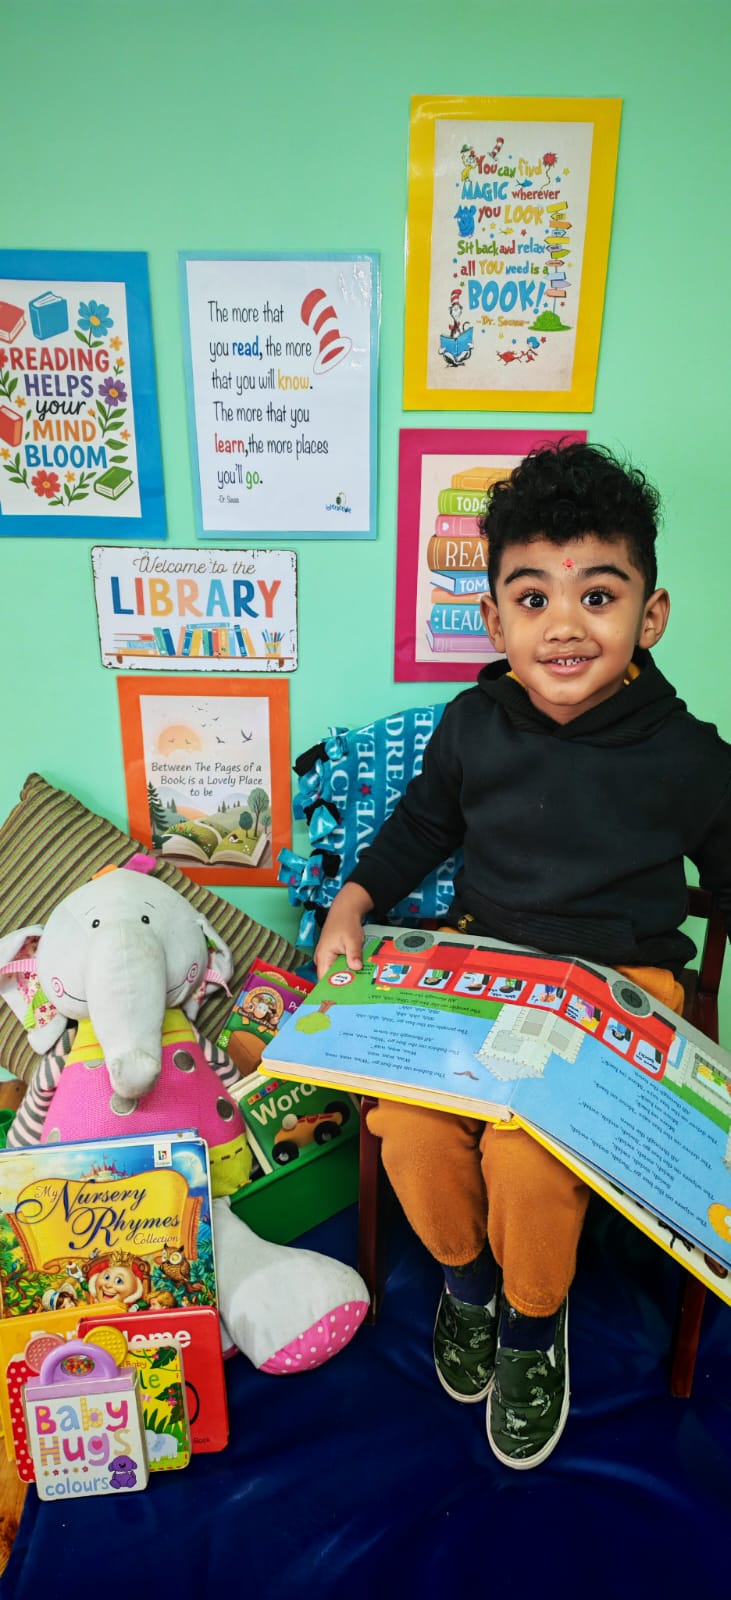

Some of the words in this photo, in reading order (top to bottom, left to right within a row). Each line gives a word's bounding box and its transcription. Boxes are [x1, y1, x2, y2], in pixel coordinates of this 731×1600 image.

[476, 155, 498, 175] You
[497, 166, 516, 178] can
[518, 157, 543, 177] find
[461, 181, 509, 202] MAGIC
[511, 188, 560, 200] wherever
[478, 206, 501, 223] you
[504, 204, 544, 225] LOOK
[457, 240, 474, 255] Sit
[475, 239, 499, 256] back
[499, 239, 516, 255] and
[517, 236, 545, 254] relax
[460, 260, 476, 276] all
[479, 259, 505, 275] YOU
[505, 260, 529, 275] need
[530, 262, 539, 275] is
[542, 266, 549, 275] a
[467, 280, 546, 314] BOOK!
[208, 301, 228, 322] The
[232, 304, 259, 323] more
[263, 301, 284, 323] that
[209, 341, 229, 362] you
[232, 335, 263, 360] read,
[265, 336, 282, 356] the
[286, 342, 312, 357] more
[9, 347, 110, 373] READING
[24, 374, 94, 398] HELPS
[212, 368, 232, 389] that
[236, 374, 256, 396] you
[258, 368, 275, 389] will
[277, 368, 313, 391] know.
[36, 400, 86, 421] your
[213, 401, 233, 422] The
[237, 407, 263, 422] more
[266, 402, 287, 422] that
[290, 408, 310, 428] you
[33, 420, 96, 442] MIND
[24, 444, 108, 469] BLOOM
[214, 432, 248, 457] learn,
[248, 433, 264, 453] the
[267, 439, 293, 453] more
[296, 433, 329, 460] places
[217, 463, 243, 489] you'll
[246, 471, 263, 489] go.
[457, 497, 487, 512] TODA
[133, 555, 207, 574] Welcome
[210, 561, 227, 574] to
[232, 561, 256, 575] the
[446, 541, 487, 567] REA
[460, 578, 489, 592] TOM
[111, 576, 282, 618] LIBRARY
[442, 609, 485, 630] LEAD
[412, 705, 434, 778] DRE
[151, 762, 192, 772] Between
[195, 762, 211, 772] The
[214, 763, 241, 774] Pages
[243, 762, 255, 772] of
[160, 776, 186, 785] Book
[188, 776, 196, 785] is
[207, 776, 236, 787] Lovely
[239, 776, 263, 785] Place
[190, 788, 200, 796] to
[204, 788, 213, 796] be
[355, 799, 376, 863] OVE
[15, 1179, 147, 1224] Nursery
[35, 1185, 58, 1202] My
[69, 1206, 180, 1249] Rhymes
[133, 1233, 179, 1246] Collection
[123, 1330, 191, 1348] ome
[35, 1397, 128, 1436] Baby
[39, 1428, 131, 1467] Hugs
[45, 1476, 109, 1497] colours
